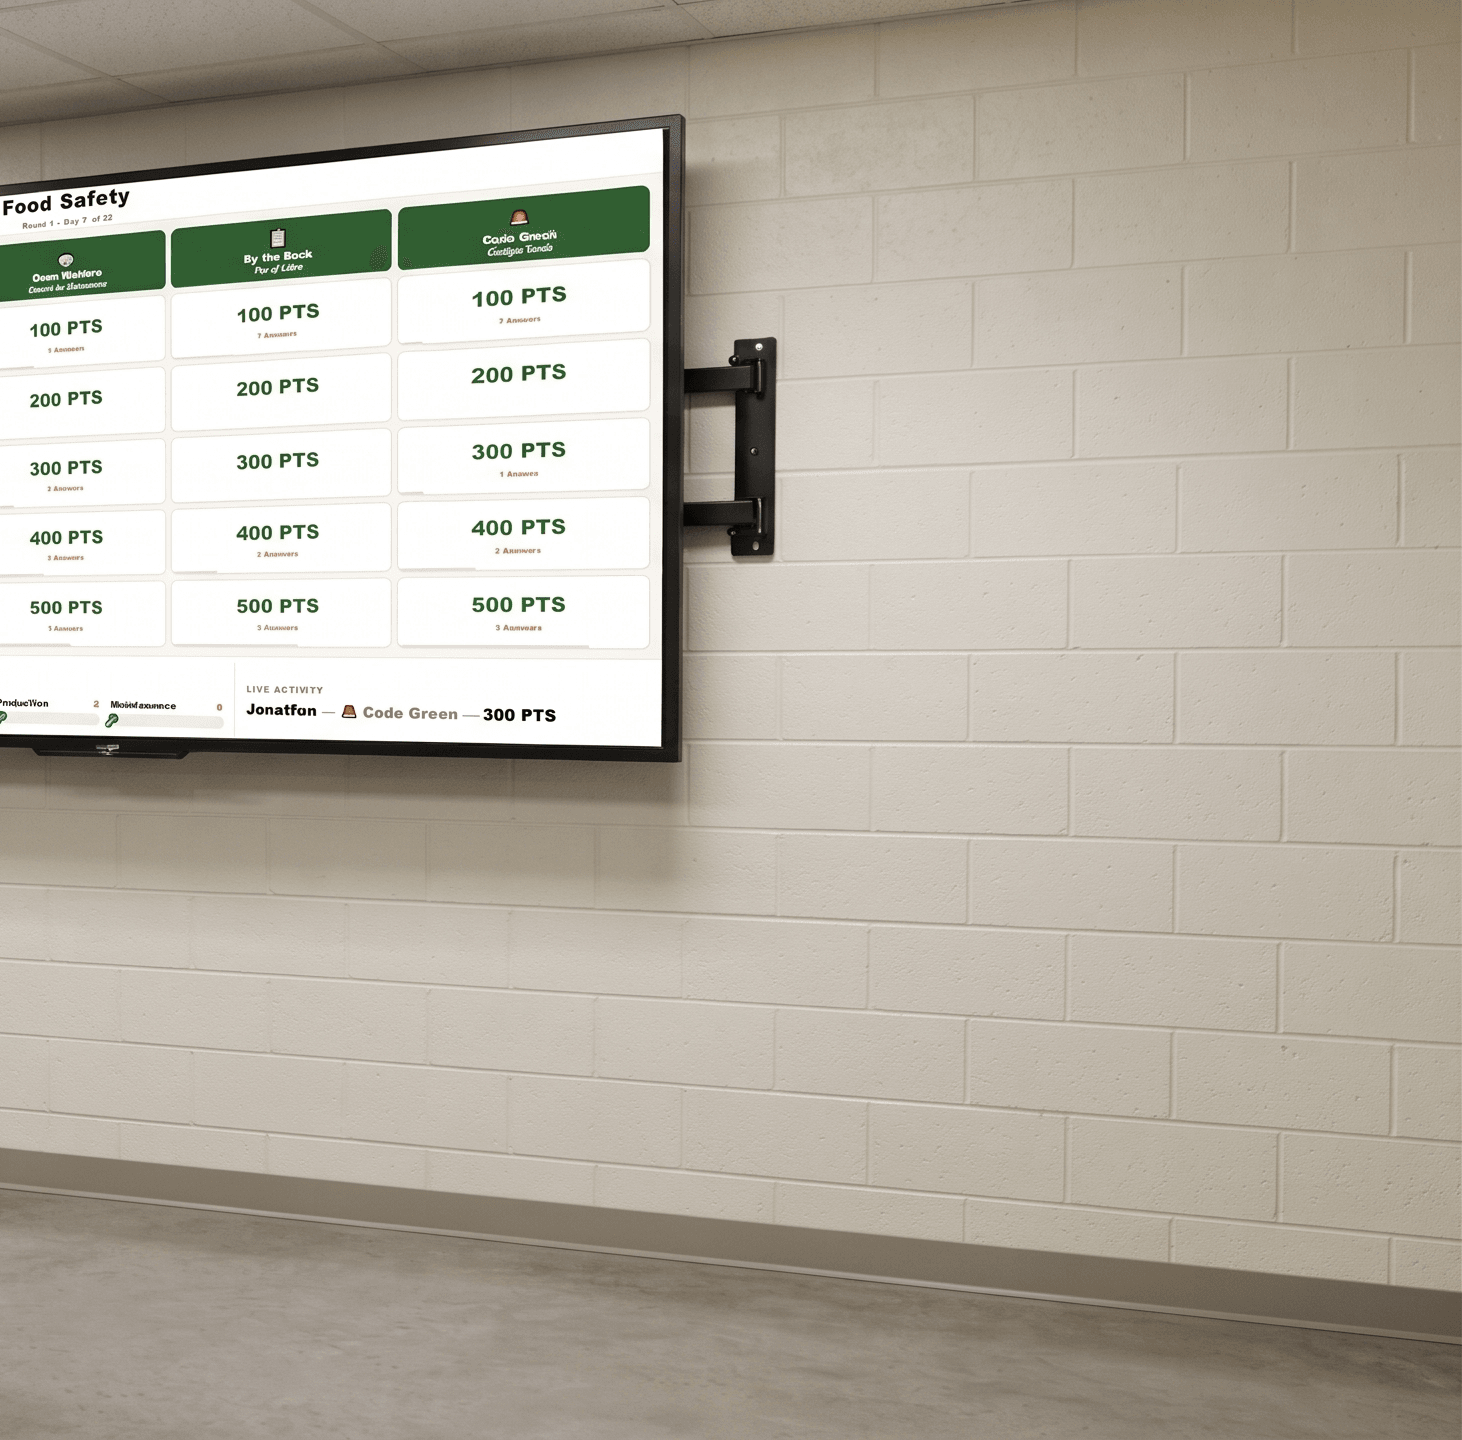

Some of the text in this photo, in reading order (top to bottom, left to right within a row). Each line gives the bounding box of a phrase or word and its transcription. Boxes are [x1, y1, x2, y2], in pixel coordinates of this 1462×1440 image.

[3, 189, 130, 215] Food Safety
[22, 221, 47, 230] Round
[64, 218, 79, 226] Day
[244, 254, 258, 266] By
[262, 253, 280, 262] the
[472, 286, 566, 307] 100 PTS
[238, 303, 319, 323] 100 PTS
[30, 319, 102, 337] 100 PTS
[471, 364, 566, 384] 200 PTS
[237, 377, 319, 396] 200 PTS
[30, 390, 102, 408] 200 PTS
[472, 442, 565, 460] 300 PTS
[30, 460, 102, 476] 300 PTS
[237, 452, 319, 470] 300 PTS
[236, 524, 319, 540] 400 PTS
[471, 519, 565, 536] 400 PTS
[30, 530, 103, 545] 400 PTS
[30, 601, 102, 614] 500 PTS
[237, 598, 319, 613] 500 PTS
[472, 596, 565, 612] 500 PTS
[274, 686, 323, 694] ACTIVITY
[93, 700, 99, 708] 2
[217, 703, 223, 711] 0
[363, 706, 404, 719] Code
[409, 707, 458, 720] Green
[483, 707, 516, 721] 300
[522, 709, 556, 722] PTS
